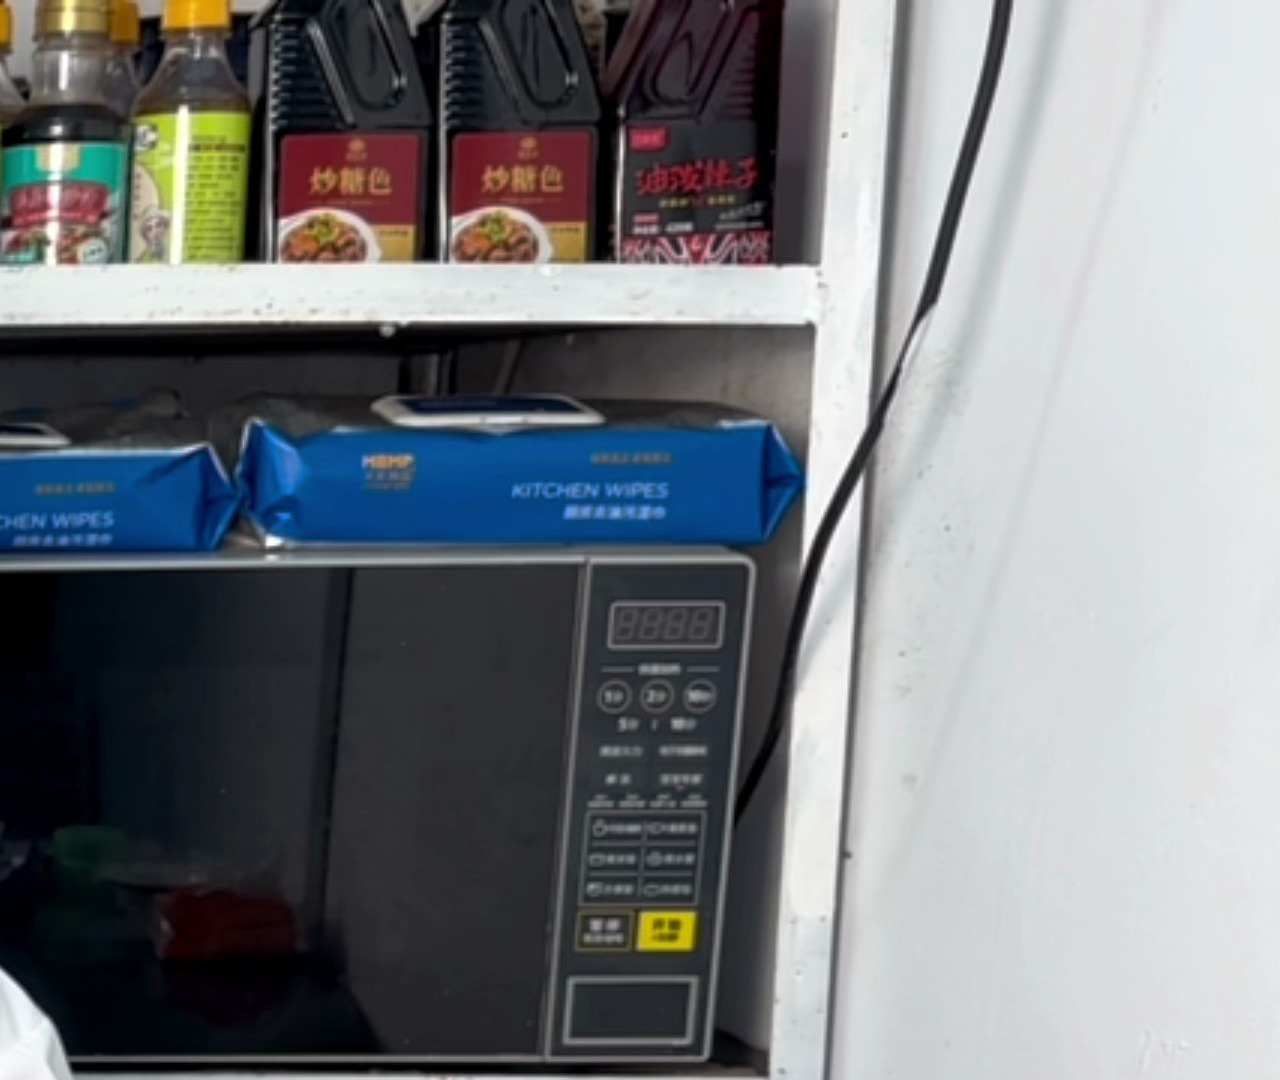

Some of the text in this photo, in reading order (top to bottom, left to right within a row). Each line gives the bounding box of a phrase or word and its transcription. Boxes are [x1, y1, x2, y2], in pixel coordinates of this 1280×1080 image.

[308, 165, 393, 196] 炒糖色
[480, 164, 565, 195] 炒糖色
[511, 482, 670, 499] KITCHEN WIPES
[51, 510, 116, 529] WIPES
